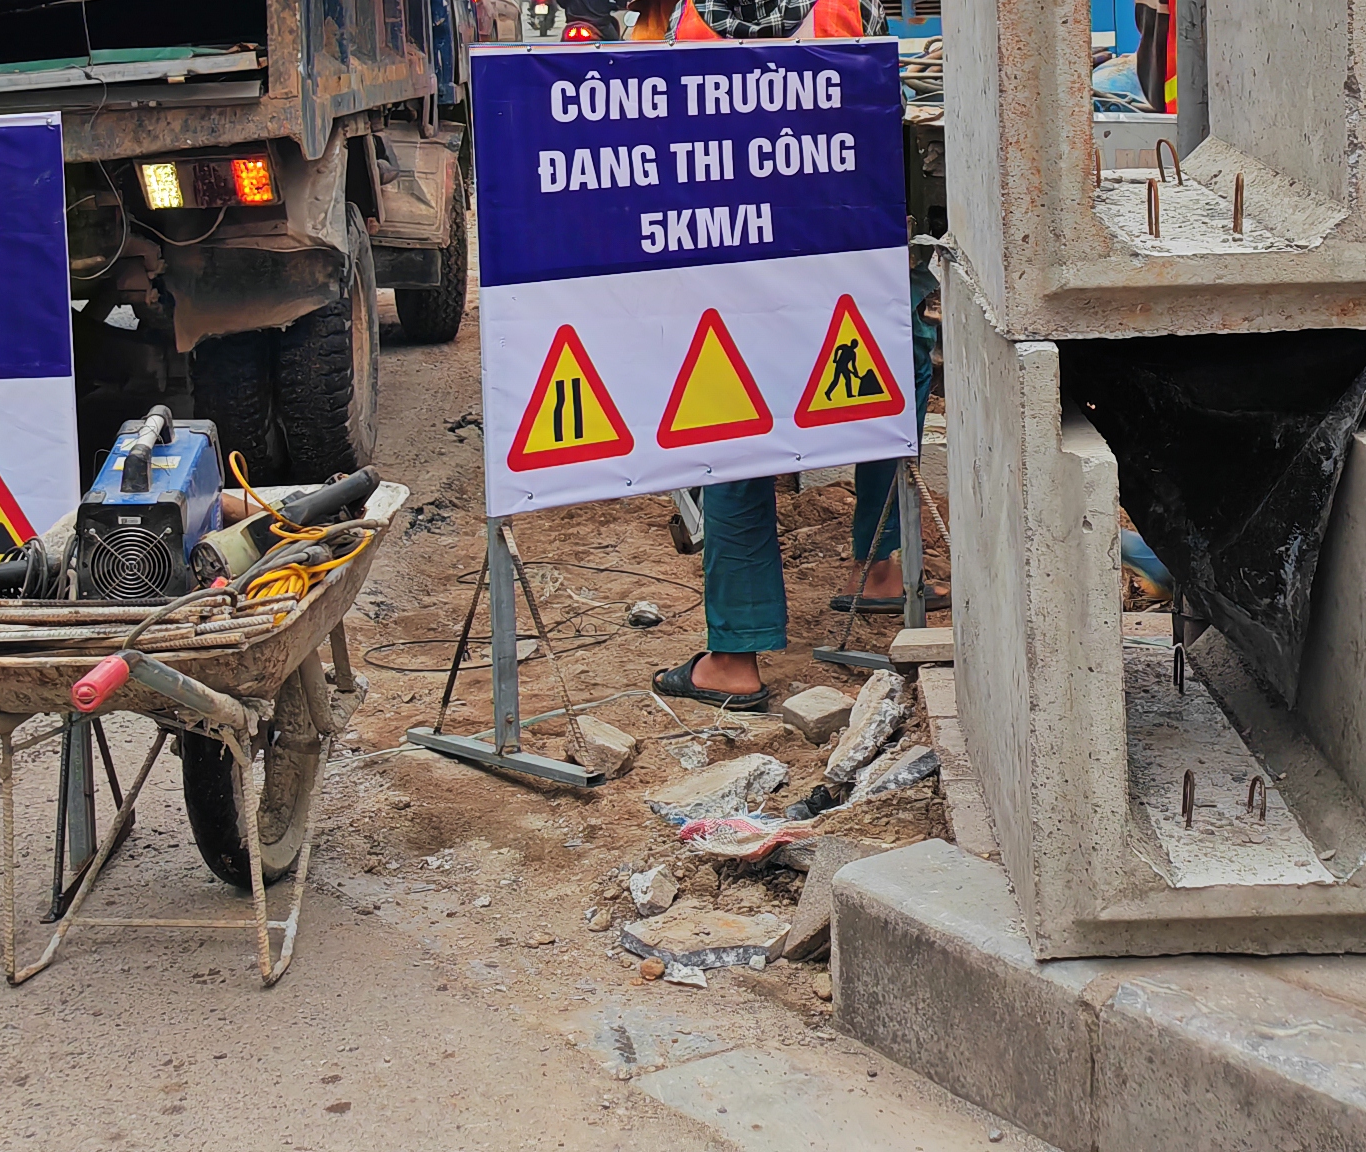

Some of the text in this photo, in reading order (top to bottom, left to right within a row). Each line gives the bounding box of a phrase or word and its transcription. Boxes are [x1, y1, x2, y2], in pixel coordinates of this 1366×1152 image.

[551, 62, 842, 123] CÔNG TRƯỜNG
[538, 127, 857, 193] ĐANG THI CÔNG
[640, 202, 774, 254] 5KM/H
